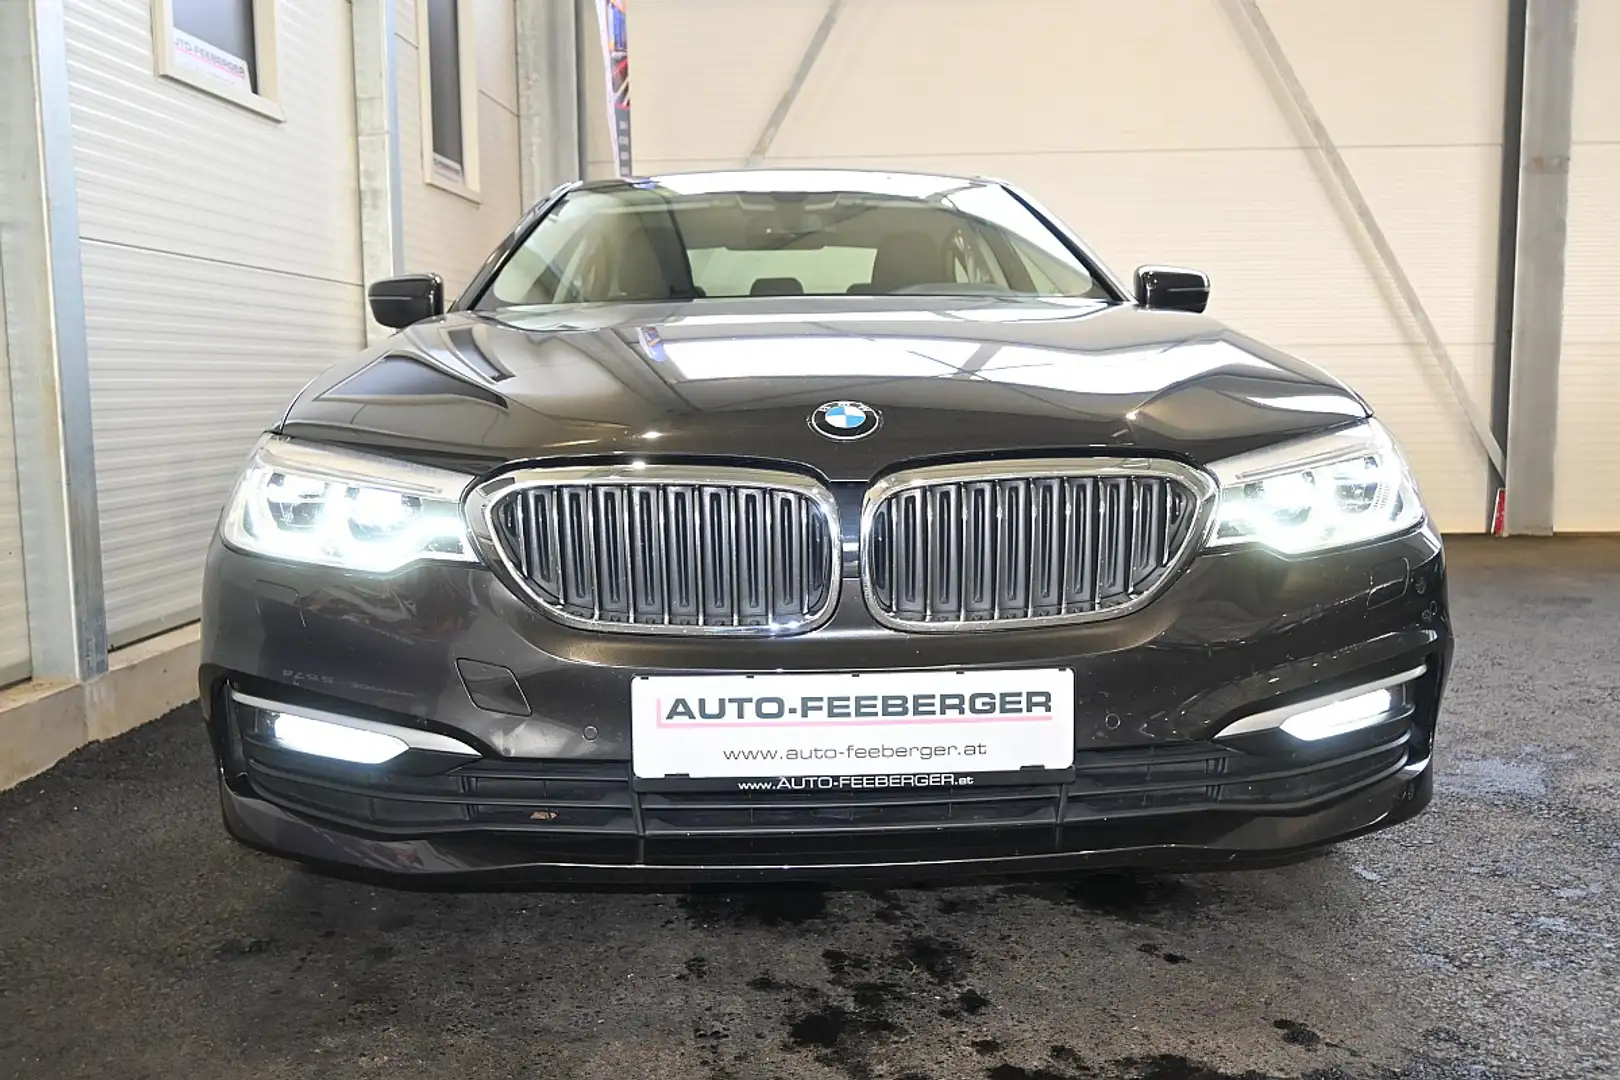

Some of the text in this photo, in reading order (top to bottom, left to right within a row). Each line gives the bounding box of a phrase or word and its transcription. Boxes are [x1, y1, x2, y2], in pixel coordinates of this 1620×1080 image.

[665, 691, 1052, 720] AUTO-FEEBERGER
[723, 742, 987, 760] www.auto-feeberger.at
[738, 773, 974, 789] www.AUTO-FEEBERGER.at
